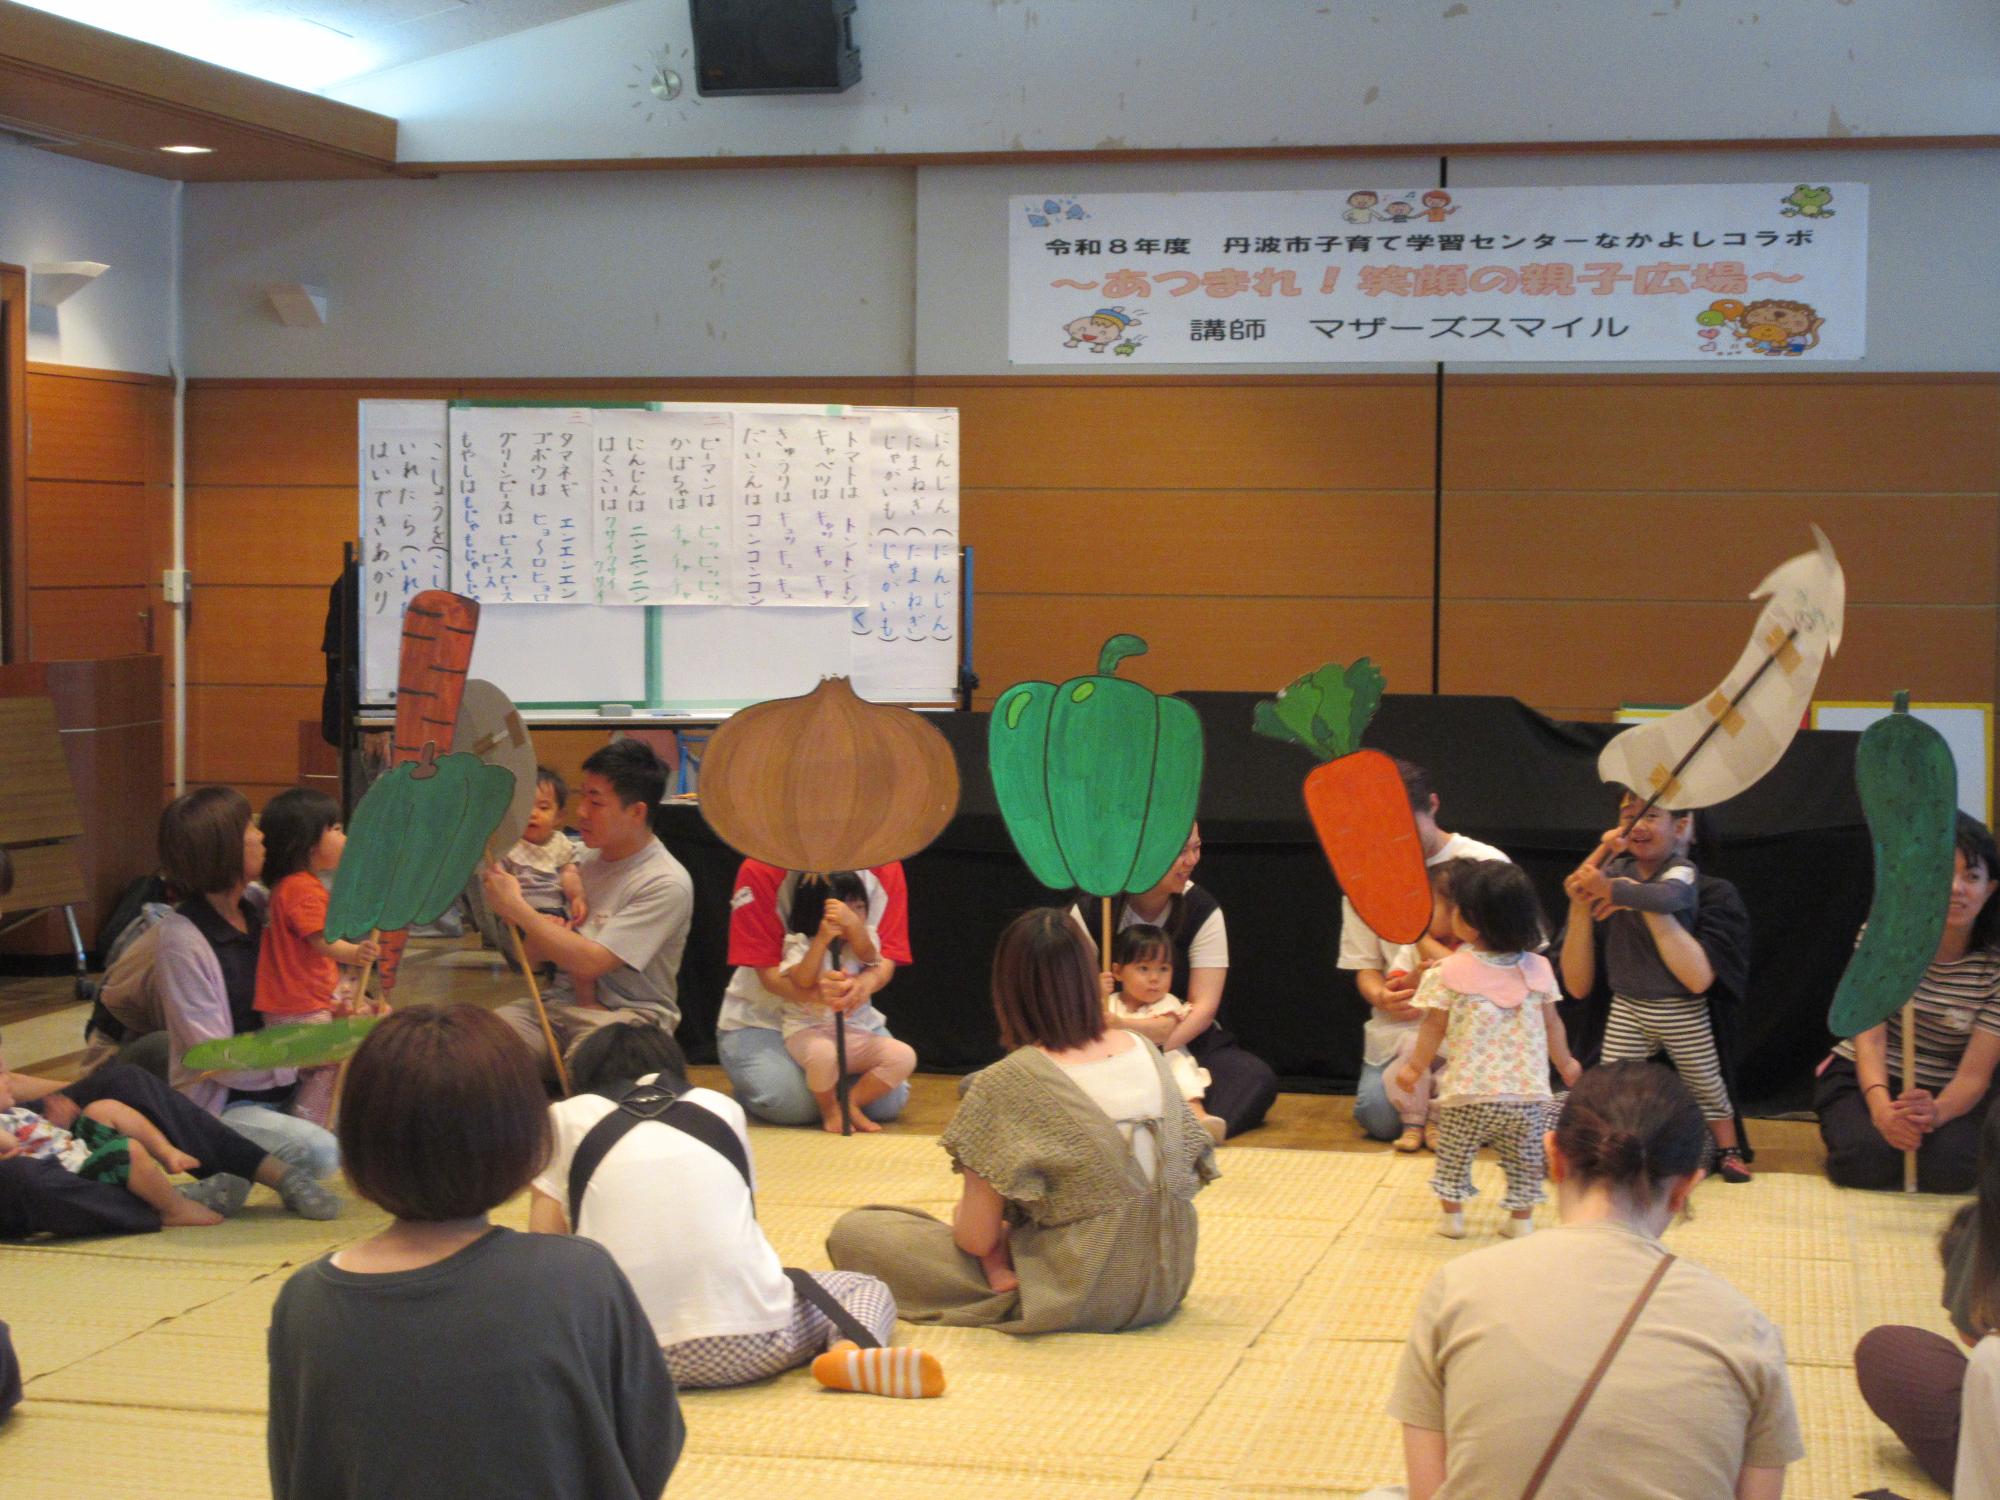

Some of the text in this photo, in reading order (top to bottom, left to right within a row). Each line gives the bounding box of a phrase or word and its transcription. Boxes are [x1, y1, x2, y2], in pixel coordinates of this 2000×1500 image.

[1045, 229, 1814, 256] 令和8年度 丹波市子育て学習センターなかよしコラボ
[1189, 315, 1630, 342] 講師 マザーズスマイル
